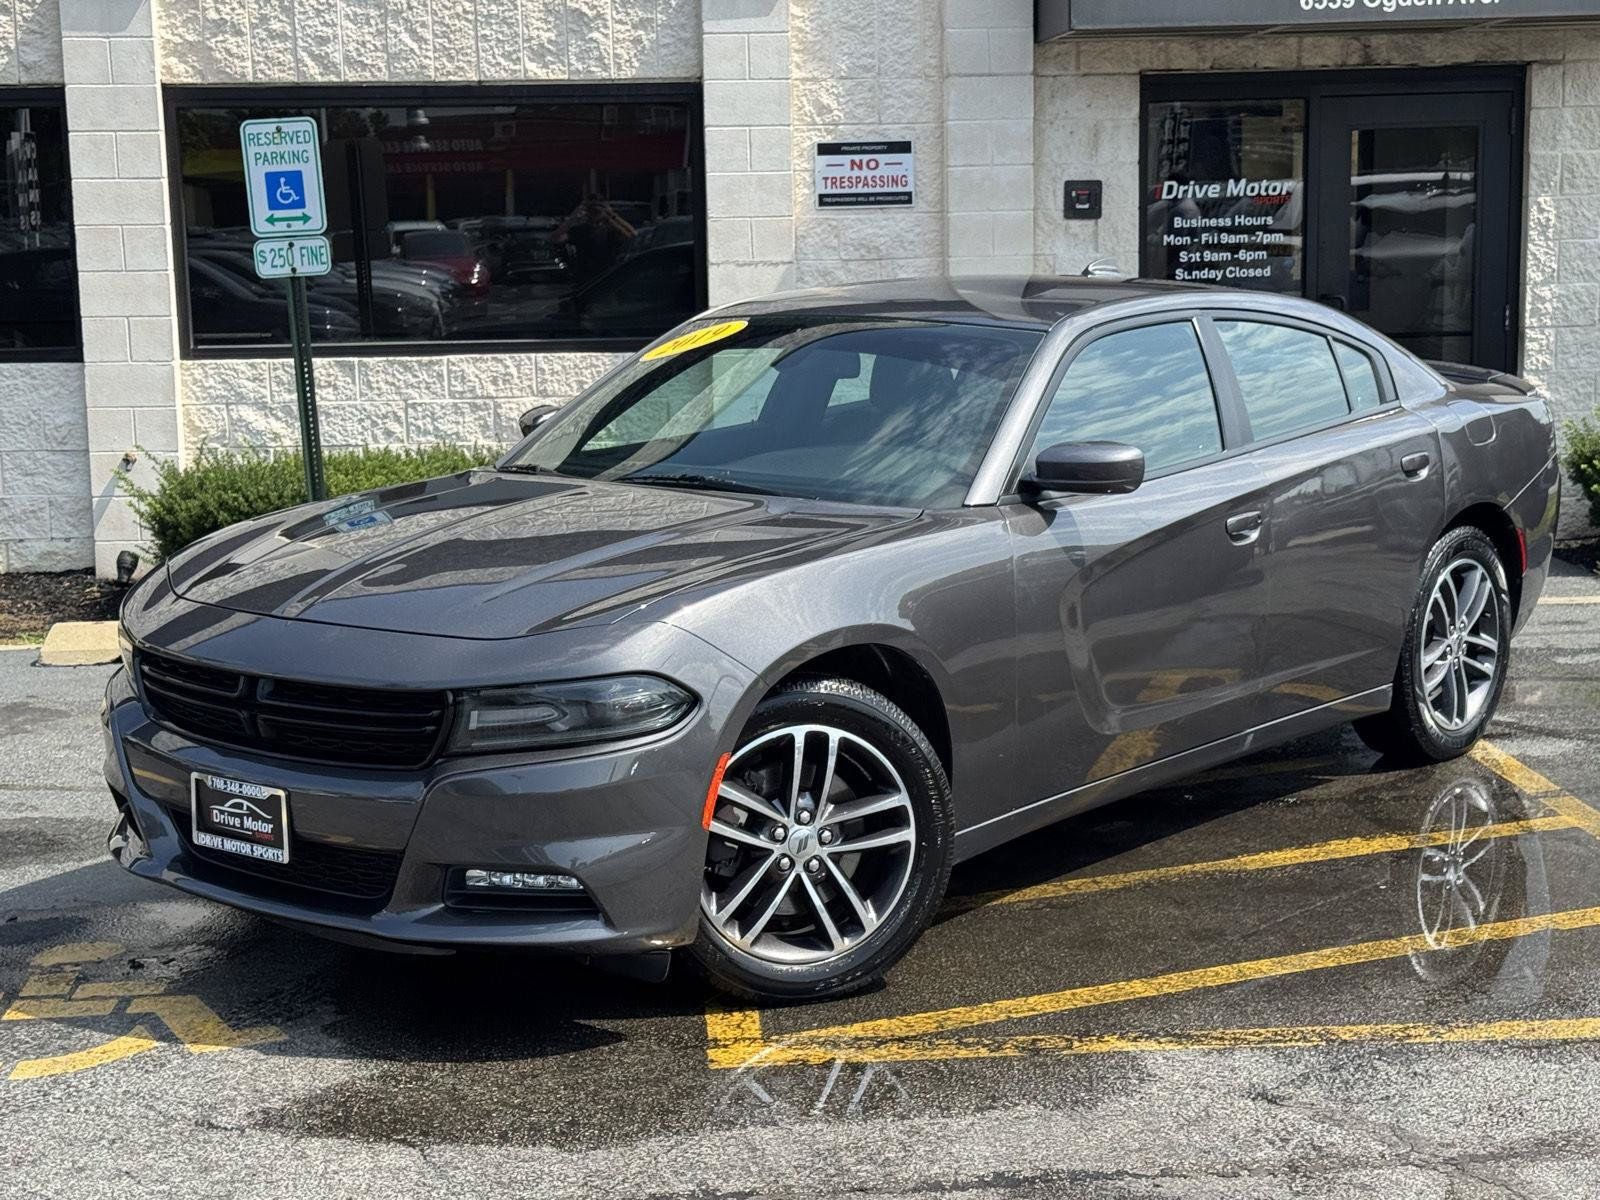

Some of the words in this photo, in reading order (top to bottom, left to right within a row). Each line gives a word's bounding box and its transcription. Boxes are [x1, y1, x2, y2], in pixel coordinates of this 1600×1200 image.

[247, 129, 311, 147] RESERVED
[254, 149, 310, 166] PARKING
[849, 158, 880, 171] NO
[822, 174, 909, 190] TRESPASSING
[1226, 178, 1298, 198] Motor
[1173, 215, 1232, 229] Business
[1234, 214, 1274, 227] Hours
[1162, 234, 1191, 246] Mon
[1220, 232, 1248, 244] 9am
[258, 247, 295, 268] $250
[300, 245, 327, 267] FINE
[1203, 250, 1232, 262] 9am
[1225, 265, 1271, 278] Closed
[243, 815, 274, 833] Motor
[223, 839, 252, 855] MOTOR
[253, 846, 283, 862] SPORTS
